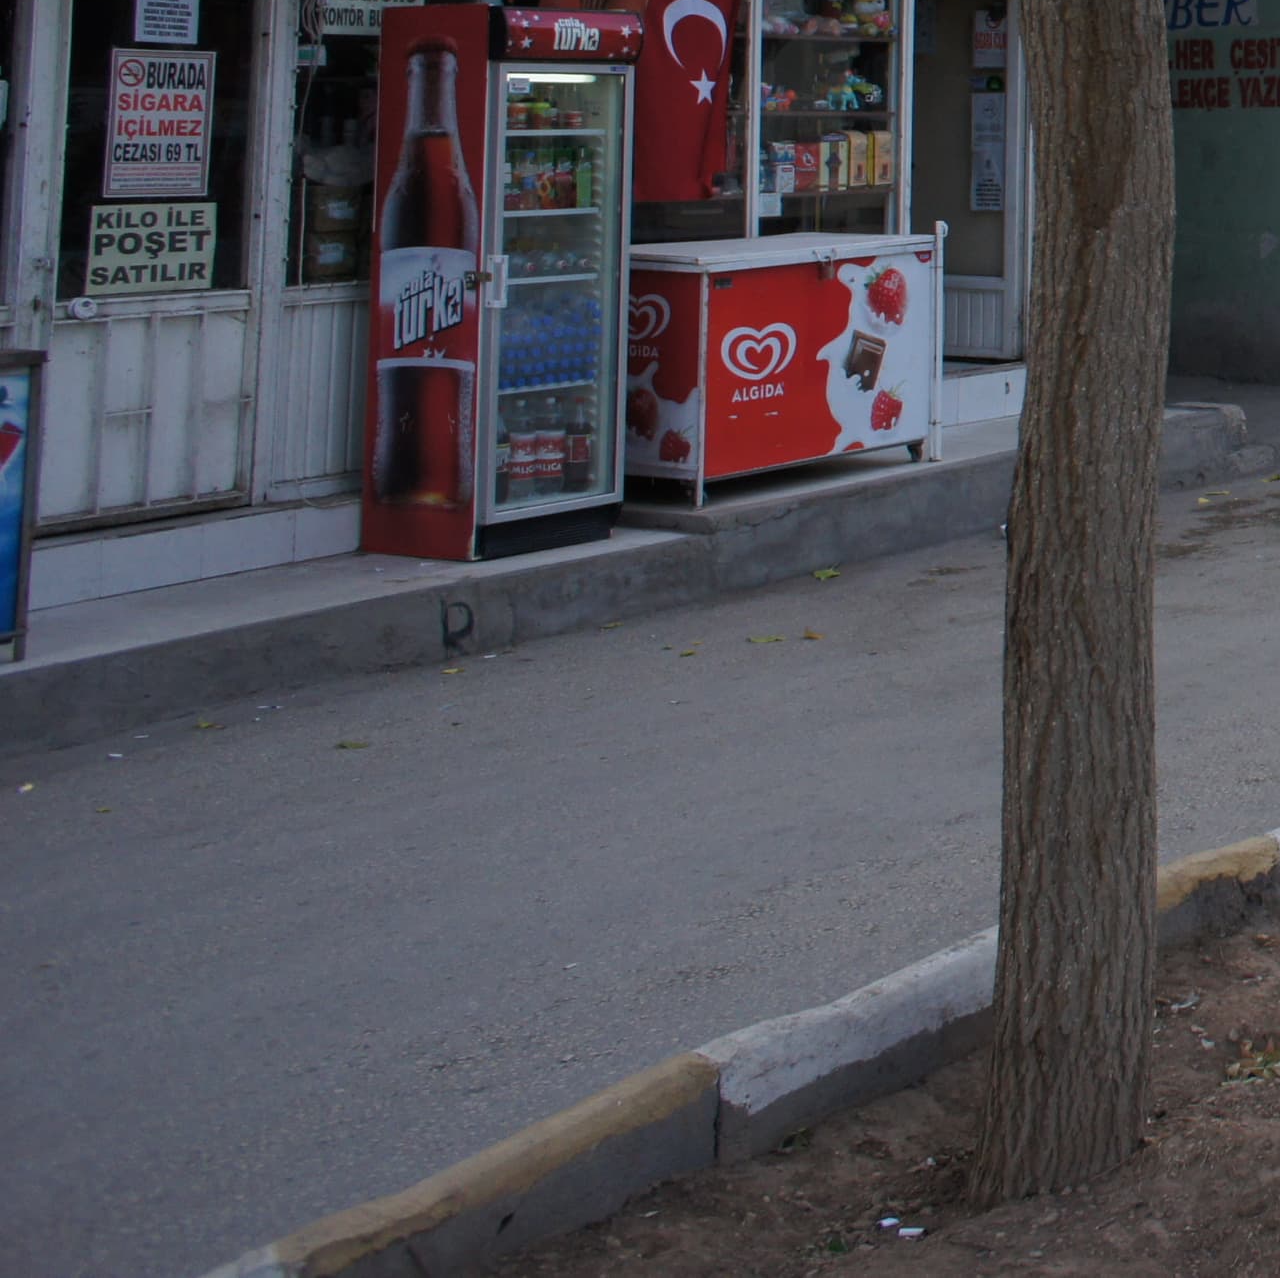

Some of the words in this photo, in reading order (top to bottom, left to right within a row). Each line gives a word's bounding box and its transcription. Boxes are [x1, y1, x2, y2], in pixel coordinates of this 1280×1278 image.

[1175, 38, 1215, 71] HER
[146, 62, 206, 90] BURADA
[118, 89, 204, 112] SİGARA
[117, 114, 203, 141] İÇİLMEZ
[113, 143, 162, 163] CEZASI
[166, 143, 182, 162] 69
[185, 143, 202, 162] TL
[96, 207, 159, 230] KİLO
[166, 206, 205, 228] İLE
[94, 227, 212, 260] POŞET
[89, 262, 208, 287] SATILIR
